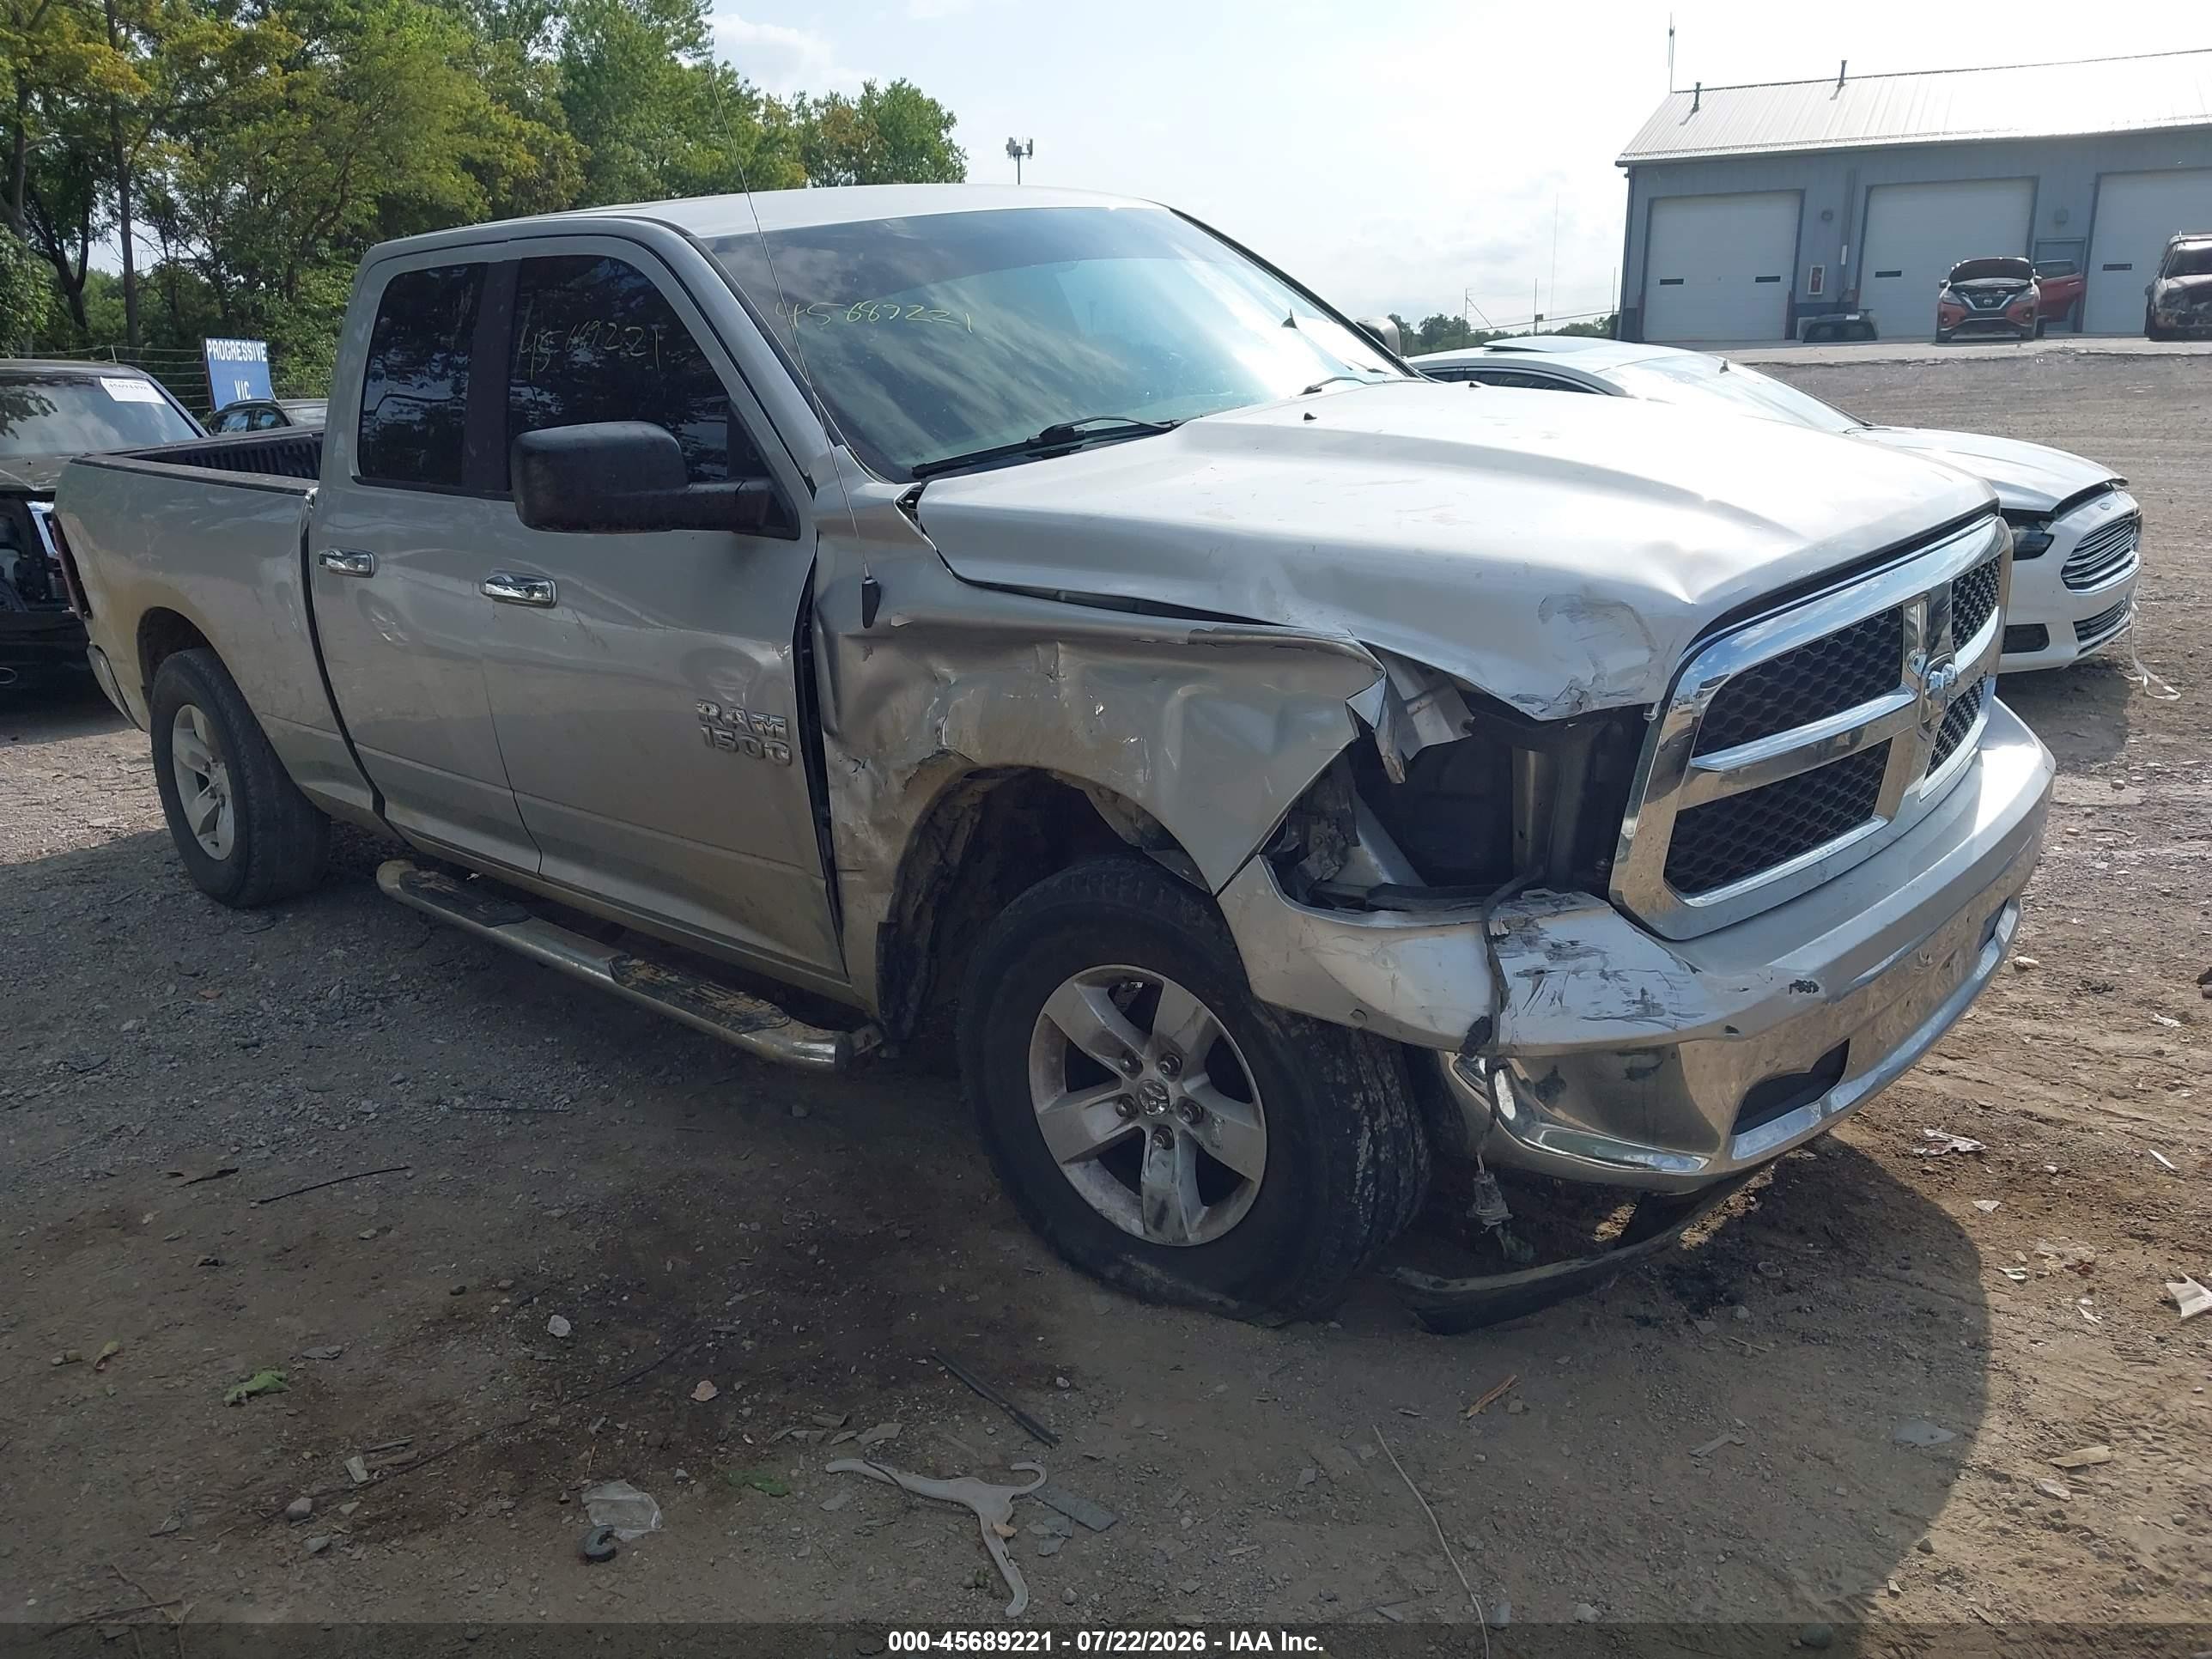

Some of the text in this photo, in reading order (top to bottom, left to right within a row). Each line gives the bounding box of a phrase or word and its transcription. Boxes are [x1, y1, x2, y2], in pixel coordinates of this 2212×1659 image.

[206, 340, 267, 362] PROGRESSIVE
[234, 380, 251, 400] VIC
[696, 699, 789, 739] RAM
[700, 724, 792, 766] 1500
